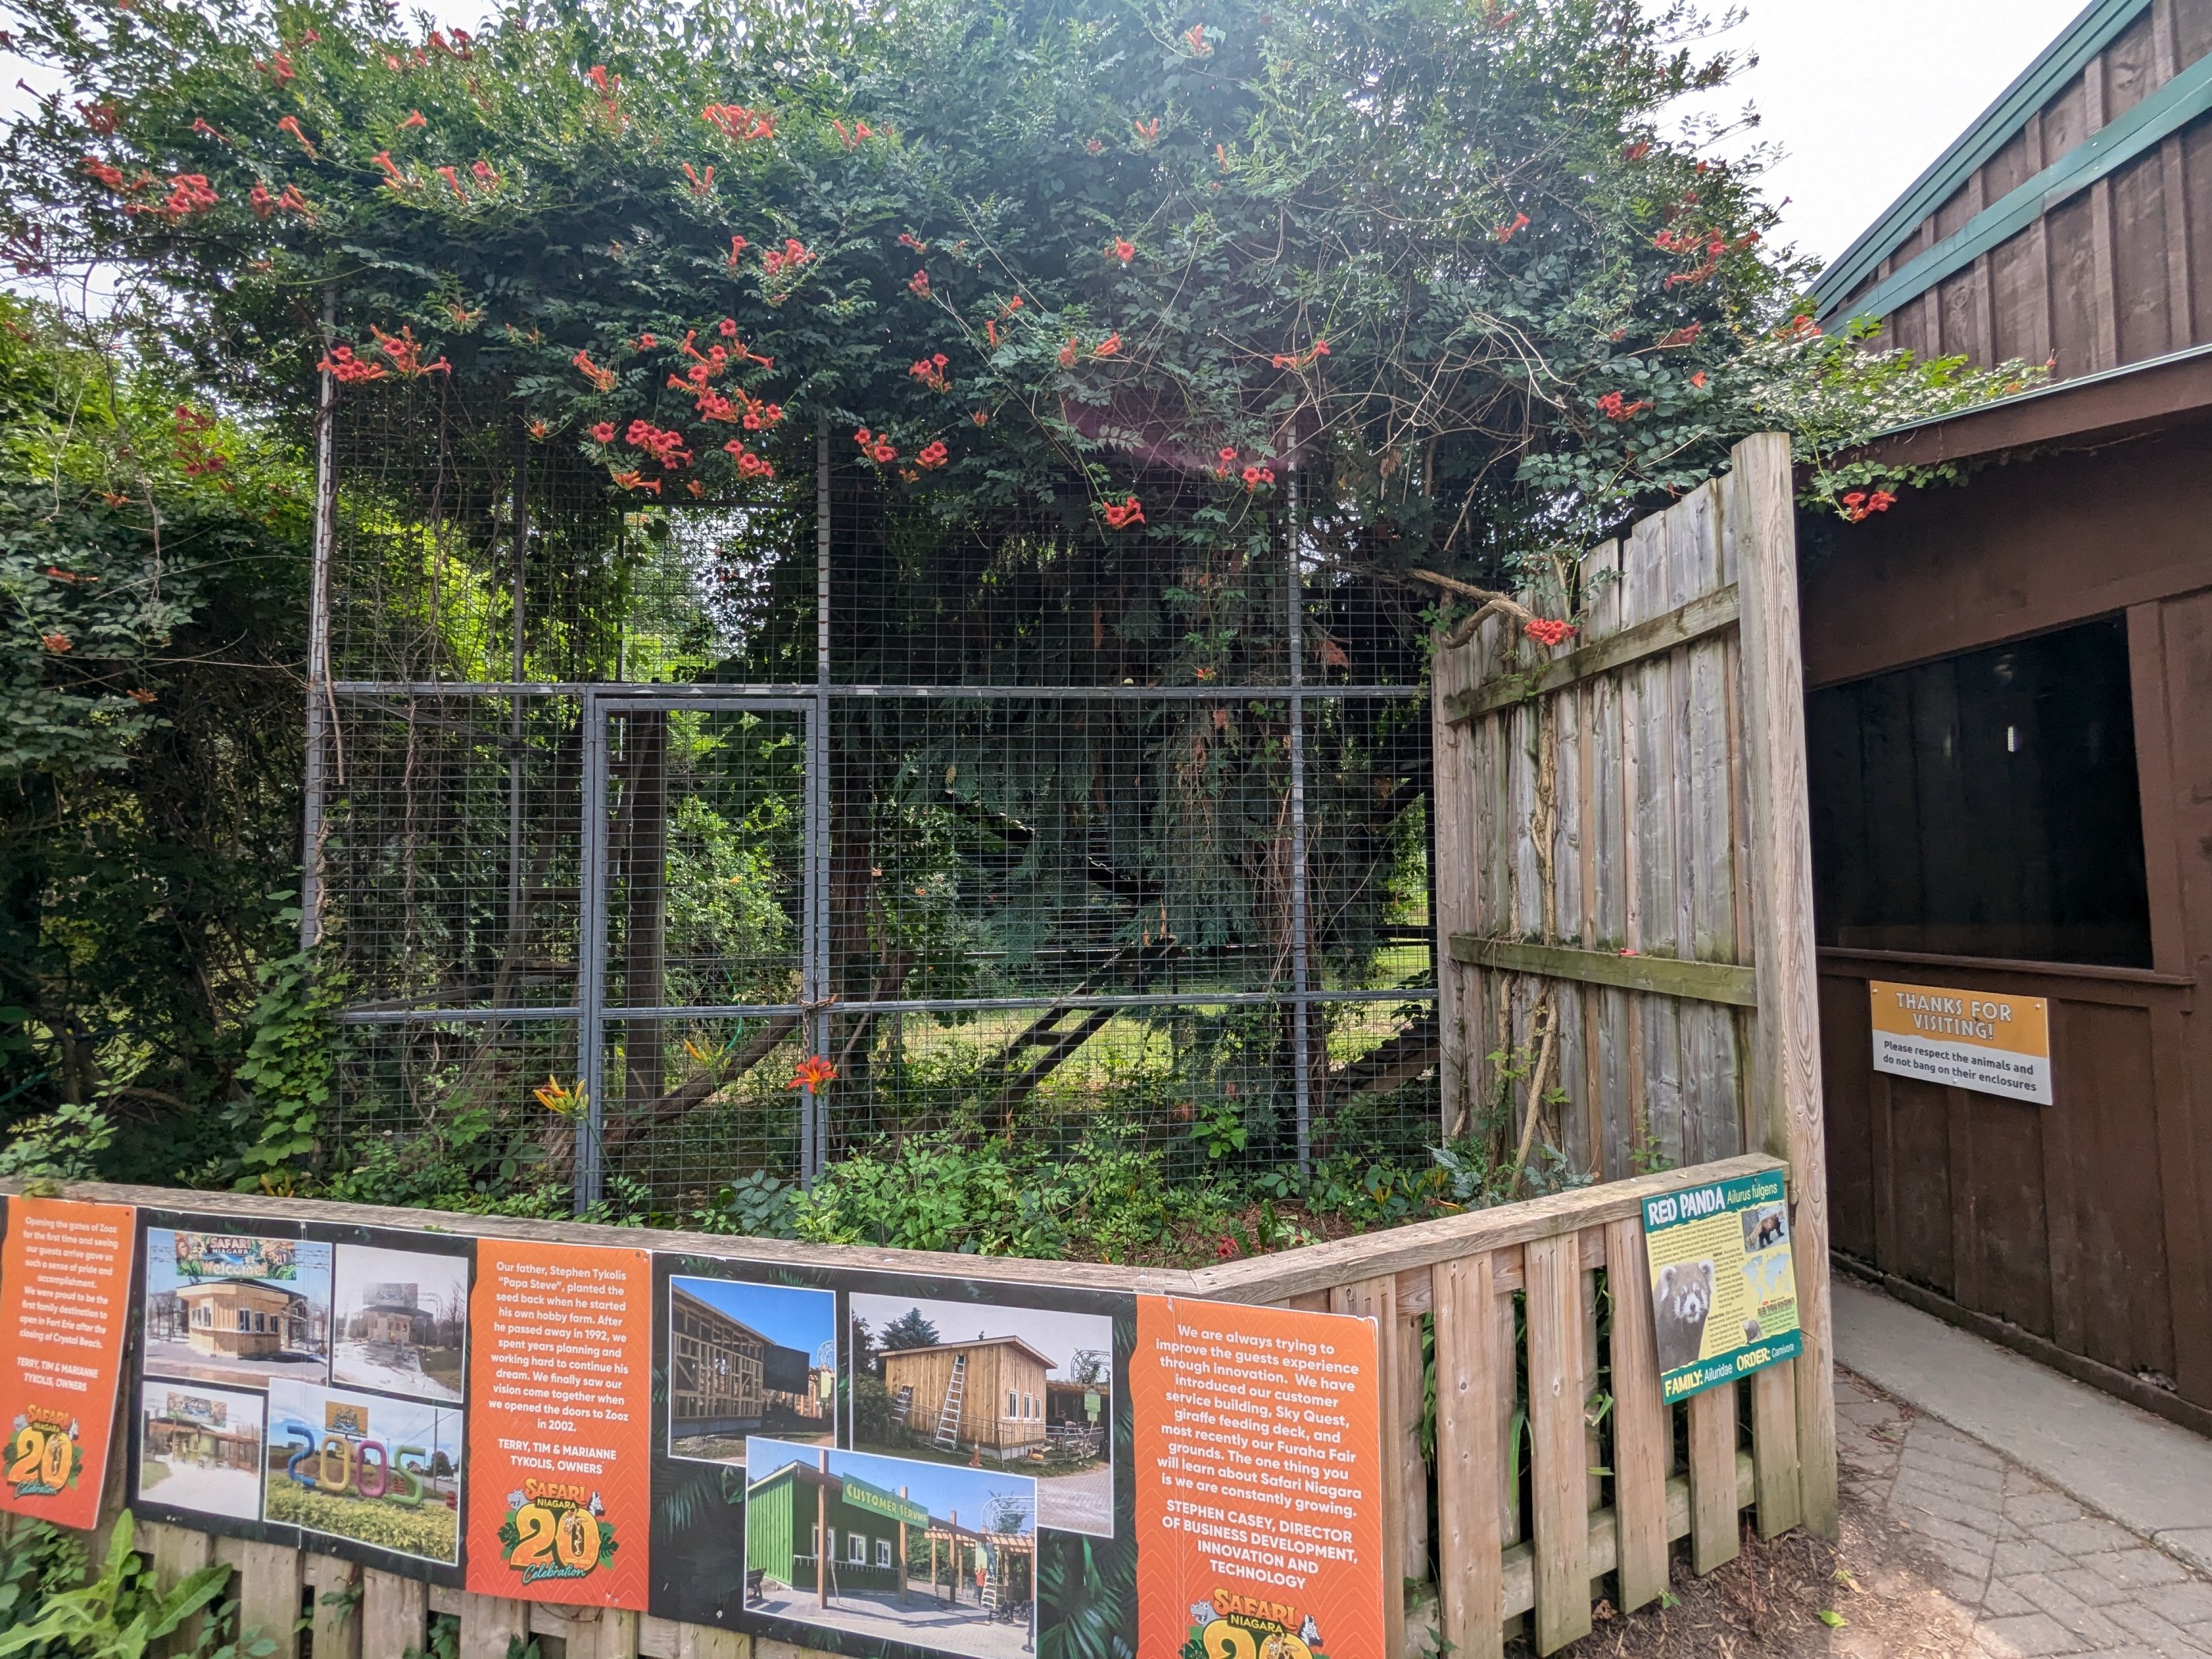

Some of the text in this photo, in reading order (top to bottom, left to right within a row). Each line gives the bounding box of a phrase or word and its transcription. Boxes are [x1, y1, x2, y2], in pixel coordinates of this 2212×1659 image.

[1896, 992, 2012, 1022] THANKS FOR
[1912, 1013, 1994, 1039] VISITING!
[1883, 1054, 2037, 1091] do not bang on their enclosures
[1884, 1041, 2034, 1075] Please respect the animals and
[1648, 1184, 1777, 1225] RED PANDA Ailurus fulgens
[210, 1237, 251, 1249] SAFARI
[496, 1261, 627, 1280] Our father, Stephen Tykolis
[495, 1293, 627, 1312] seed back when he started
[567, 1282, 605, 1294] planted
[608, 1285, 624, 1296] the
[498, 1306, 623, 1326] his own hobby farm. After
[494, 1321, 627, 1343] he passed away in 1992, we
[1177, 1324, 1335, 1356] We are always trying to
[491, 1353, 629, 1374] working hard to continue his
[498, 1339, 622, 1358] spent years planning and
[1156, 1338, 1359, 1375] improve the guests experience
[41, 1361, 54, 1370] TIM
[495, 1368, 622, 1389] dream. We finally saw our
[1160, 1356, 1356, 1392] through innovation. We have
[1665, 1370, 1704, 1397] FAMILY:
[1704, 1363, 1733, 1382] Ailuridae
[1737, 1348, 1770, 1371] ORDER:
[493, 1382, 625, 1406] vision come together when
[1174, 1372, 1339, 1408] introduced our customer
[28, 1404, 69, 1426] SAFARI
[488, 1399, 629, 1423] we opened the doors to Zooz
[537, 1418, 577, 1432] in 2002.
[1166, 1391, 1349, 1429] service building, Sky Quest,
[1174, 1408, 1341, 1443] giraffe feeding deck, and
[8, 1426, 72, 1490] 20
[498, 1438, 617, 1460] TERRY, TIM & MARIANNE
[1161, 1425, 1356, 1463] most recently our Furaha Fair
[510, 1455, 602, 1475] TYKOLIS, OWNERS
[1168, 1442, 1349, 1480] grounds. The one thing you
[525, 1479, 588, 1505] SAFARI
[1157, 1456, 1362, 1499] will learn about Safari Niagara
[538, 1498, 576, 1509] NIAGARA
[846, 1484, 928, 1523] CUSTOMER SERVICE
[1161, 1472, 1357, 1519] is we are constantly growing.
[510, 1502, 601, 1570] 20
[1167, 1498, 1353, 1544] STEPHEN CASEY, DIRECTOR
[1162, 1515, 1358, 1565] OF BUSINESS DEVELOPMENT,
[523, 1561, 585, 1583] Celebration
[1197, 1539, 1319, 1575] INNOVATION AND
[1210, 1559, 1306, 1590] TECHNOLOGY
[1214, 1588, 1298, 1631] SAFARI
[1230, 1615, 1283, 1633] NIAGARA
